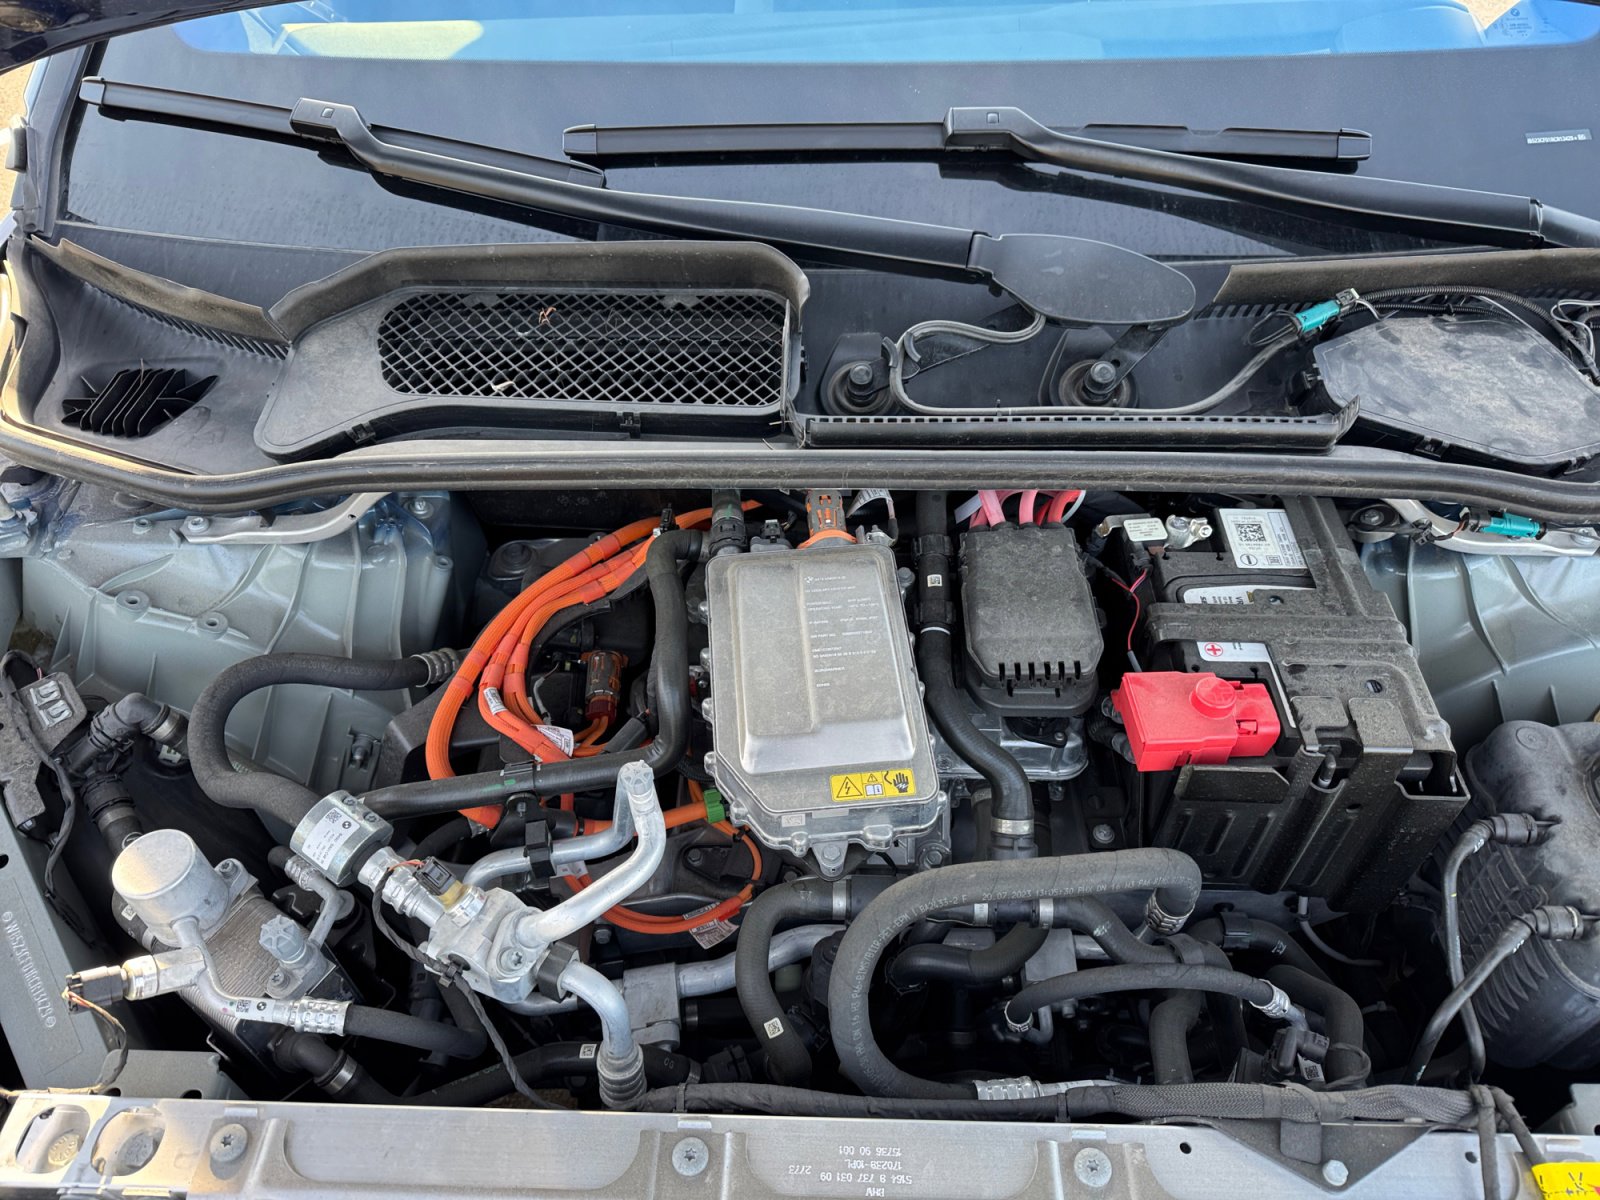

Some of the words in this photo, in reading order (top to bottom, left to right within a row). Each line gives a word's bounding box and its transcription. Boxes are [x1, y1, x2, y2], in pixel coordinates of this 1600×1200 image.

[981, 890, 1032, 901] 20.07.2023
[859, 1146, 872, 1156] 90
[819, 1171, 832, 1181] 09
[836, 1172, 853, 1182] 031
[857, 1173, 874, 1183] 737
[865, 1187, 885, 1197] BMW
